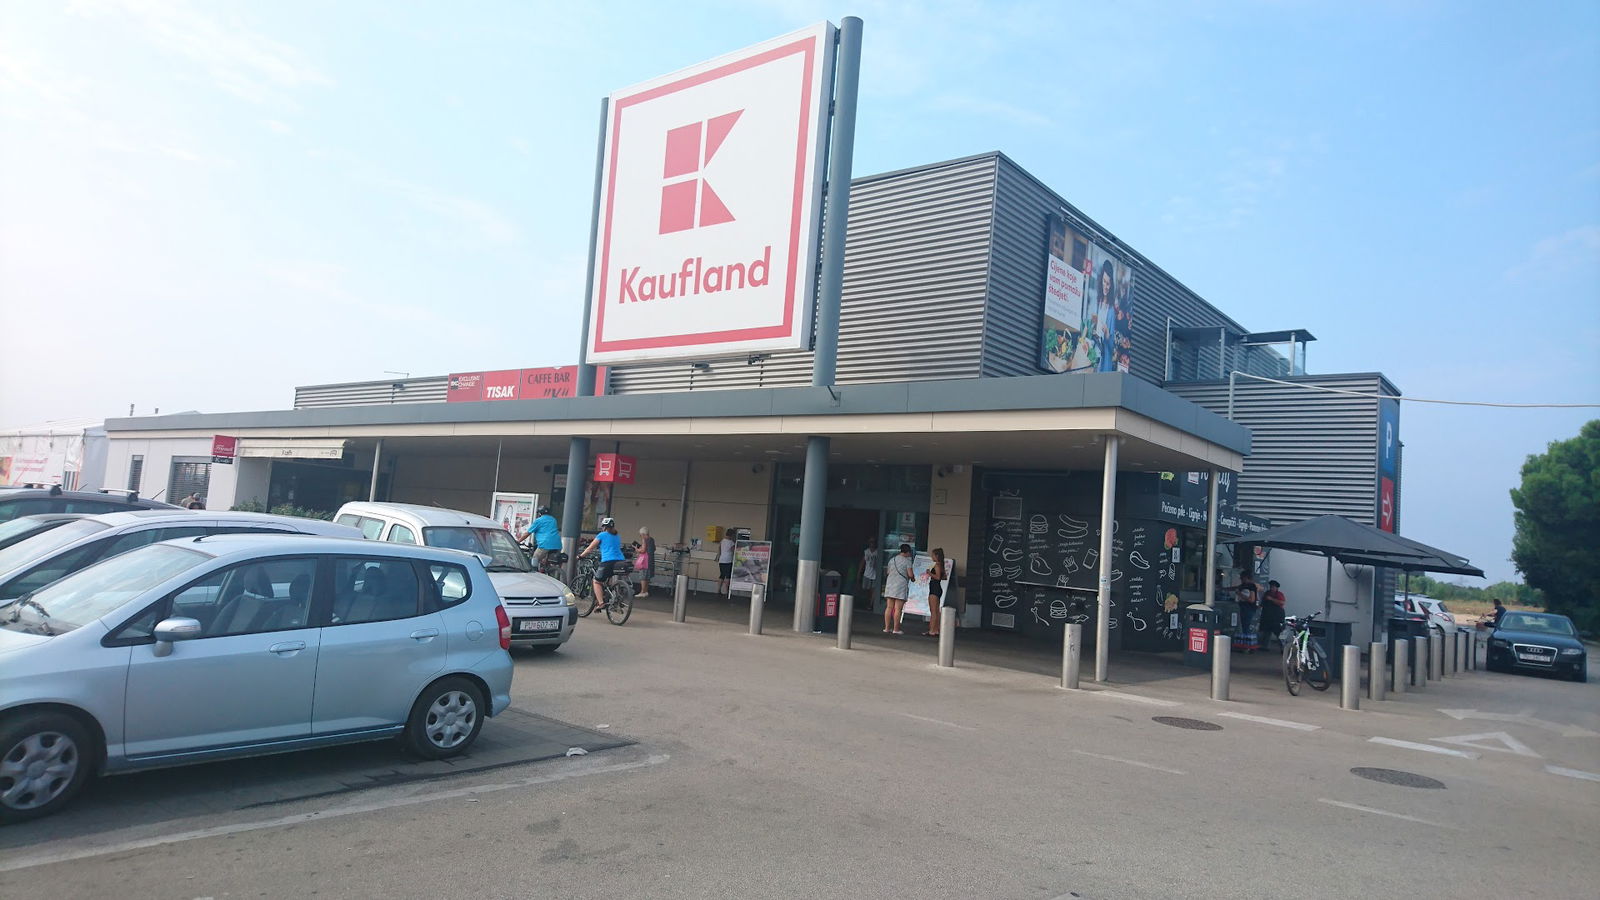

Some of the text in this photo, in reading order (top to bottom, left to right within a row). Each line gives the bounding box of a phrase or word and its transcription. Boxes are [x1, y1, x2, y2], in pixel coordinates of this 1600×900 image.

[619, 245, 771, 304] Kaufland
[528, 372, 570, 384] CAFFE BAR
[486, 385, 515, 398] TISAK
[1386, 421, 1392, 459] P
[1161, 501, 1177, 515] Pečeno
[1177, 504, 1185, 519] pile
